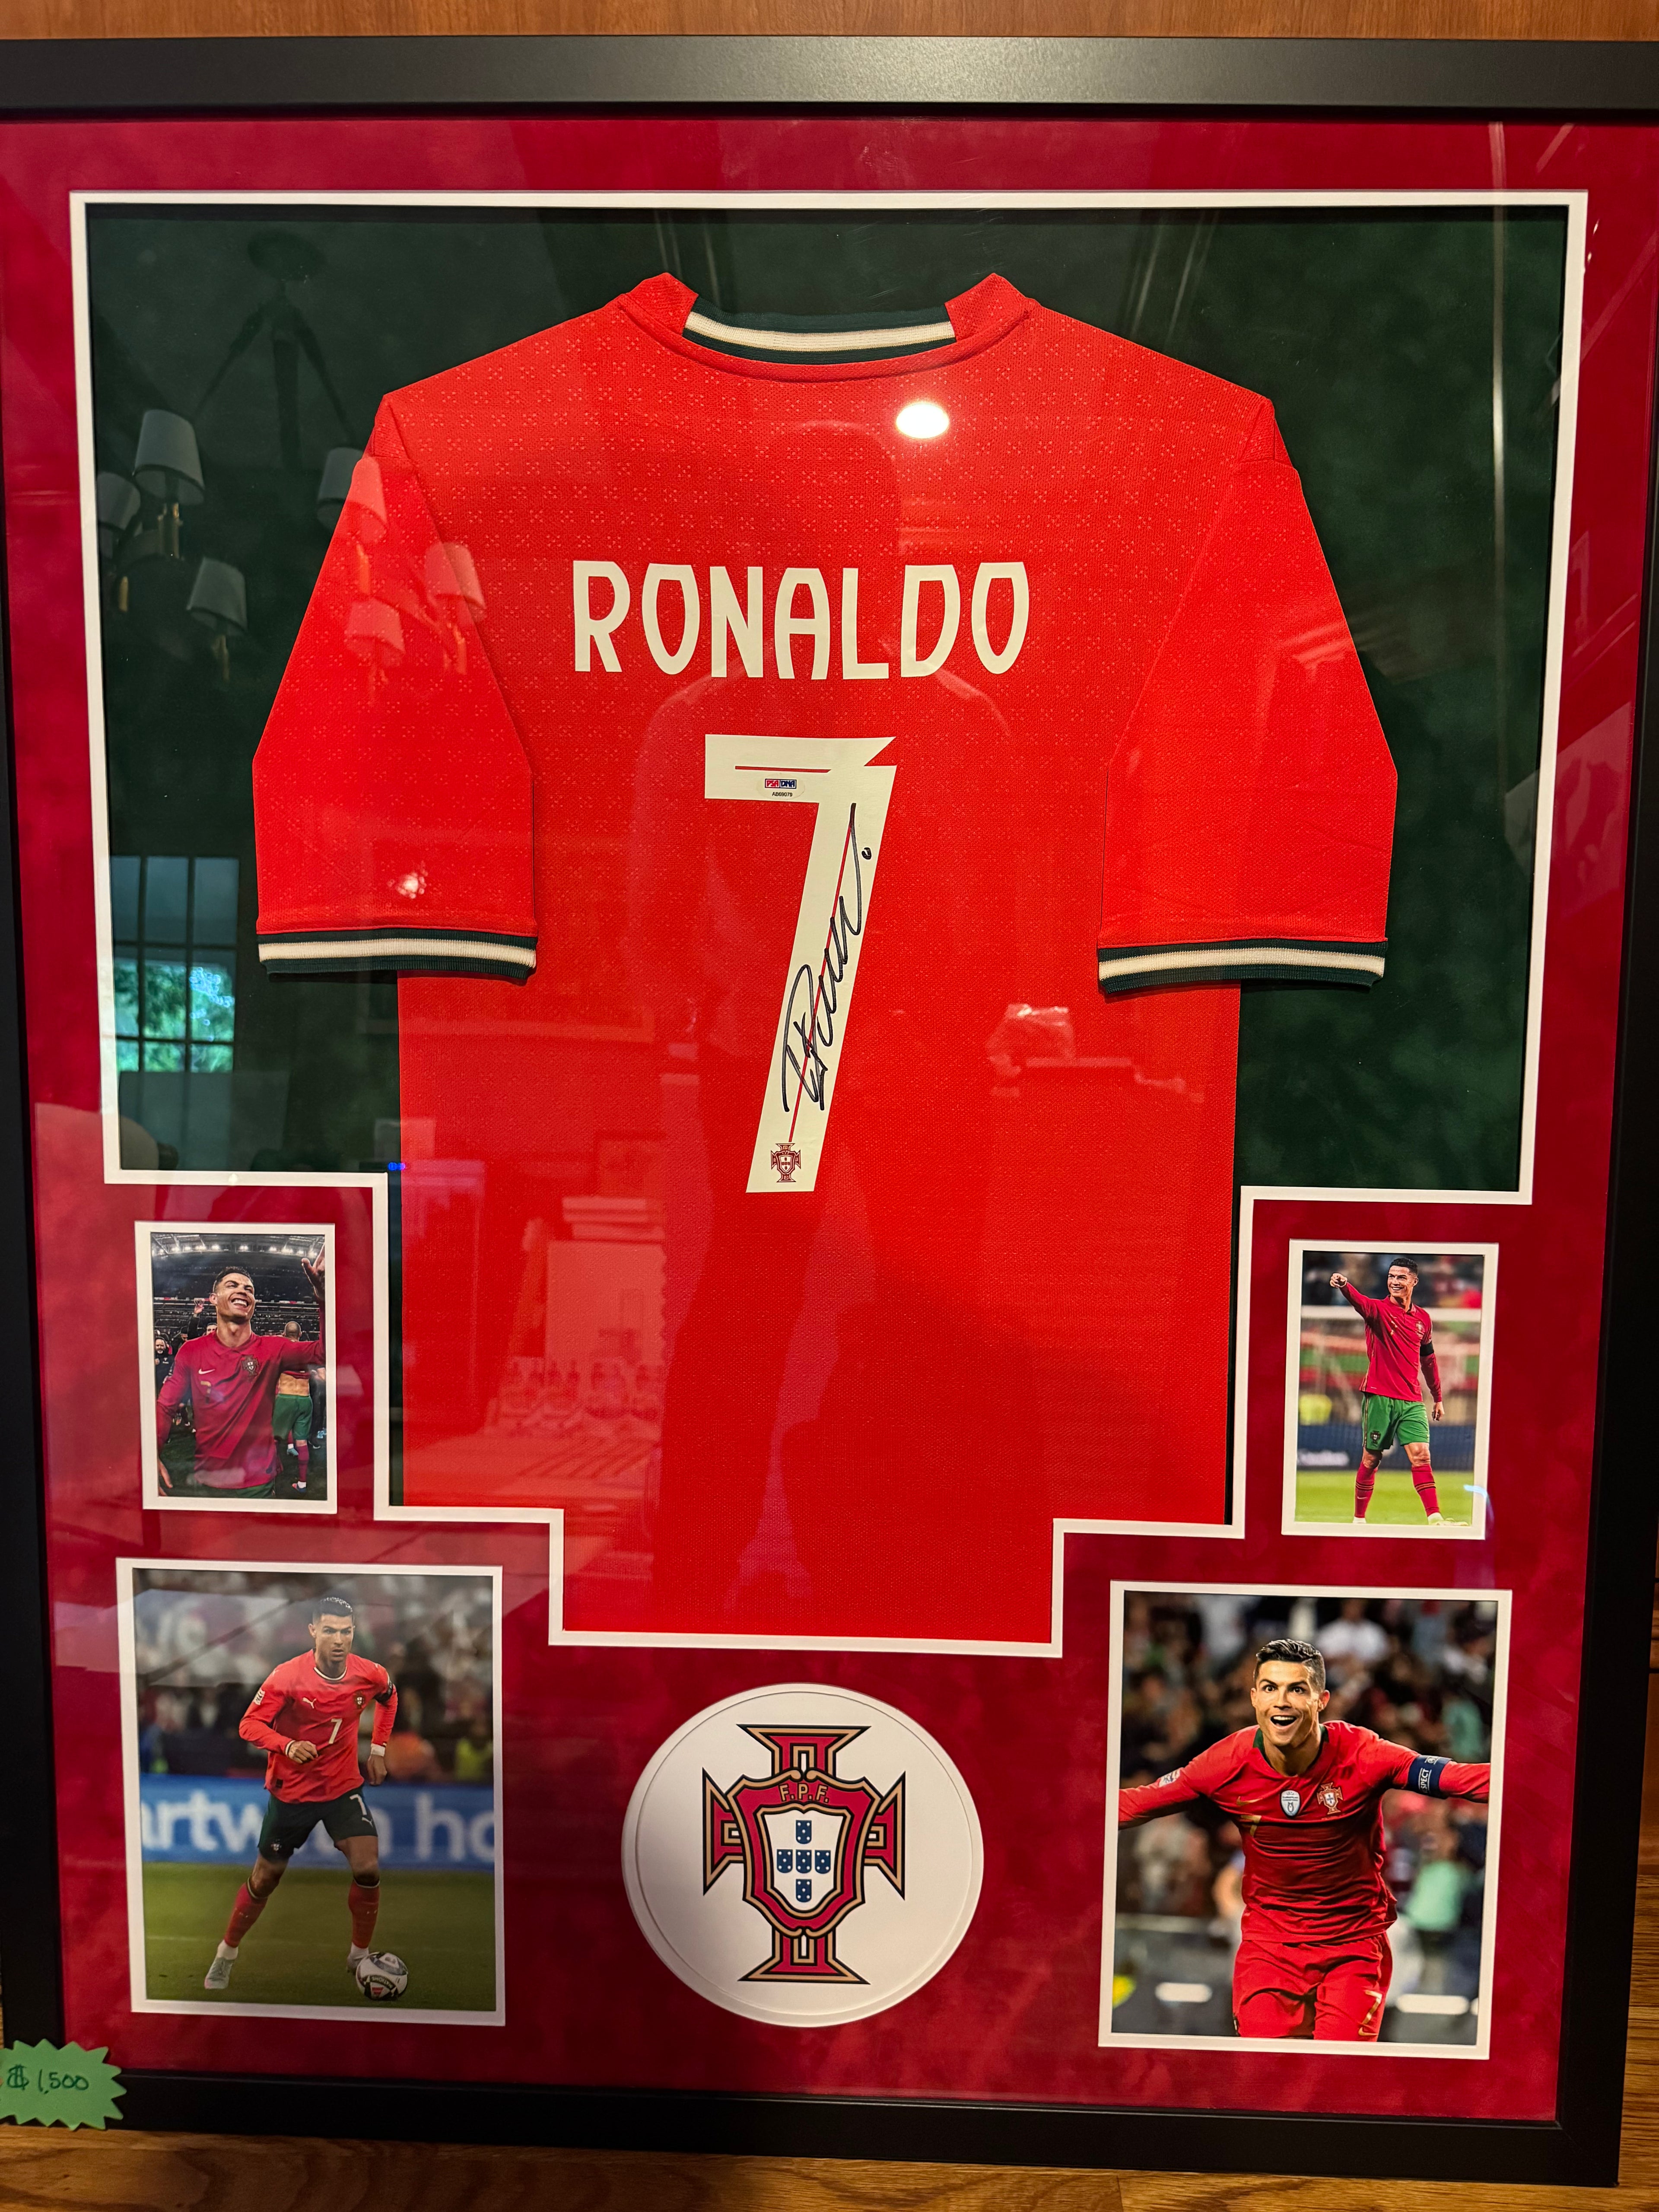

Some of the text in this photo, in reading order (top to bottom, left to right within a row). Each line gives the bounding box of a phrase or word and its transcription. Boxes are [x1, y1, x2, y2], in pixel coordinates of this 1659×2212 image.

[573, 560, 1029, 680] RONALDO
[705, 734, 897, 1193] 7
[331, 1718, 343, 1745] 7
[1420, 1768, 1430, 1792] SPECT
[349, 1794, 367, 1815] 7
[1363, 1990, 1383, 2024] 7
